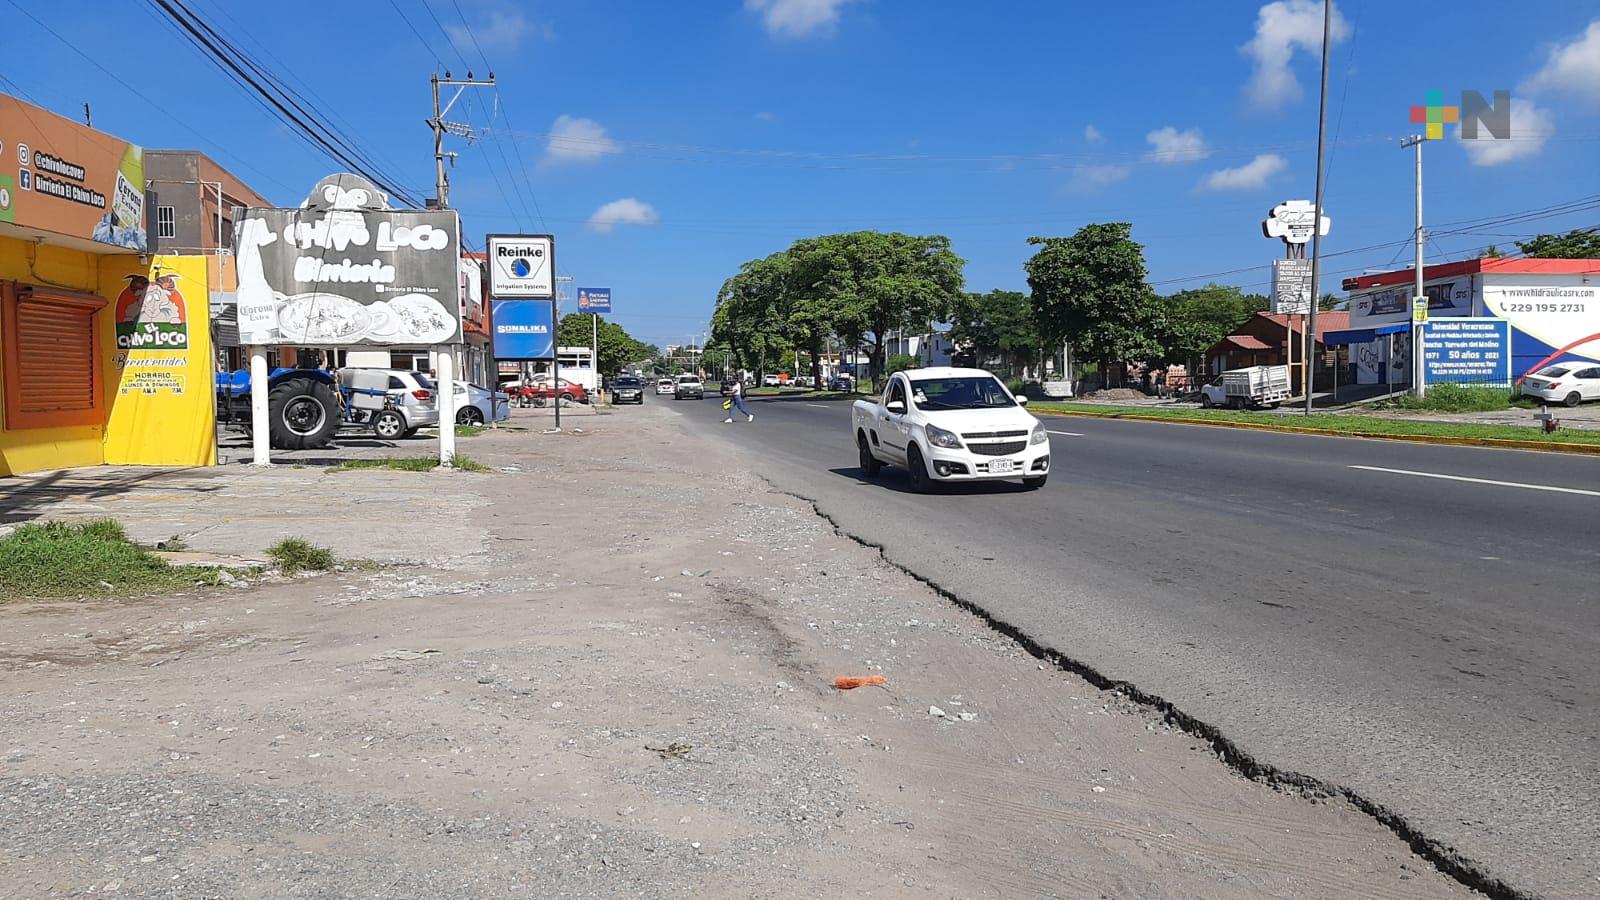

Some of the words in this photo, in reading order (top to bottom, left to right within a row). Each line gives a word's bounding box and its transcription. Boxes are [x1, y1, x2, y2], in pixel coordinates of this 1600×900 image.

[35, 152, 84, 180] @chivolocover
[35, 175, 65, 196] Birrieria
[66, 184, 72, 198] El
[72, 186, 90, 203] Chivo
[91, 191, 105, 207] Loco
[118, 175, 141, 207] Corona
[120, 195, 137, 215] Extra
[498, 246, 543, 257] Reinke
[293, 256, 396, 283] Birrieria
[496, 283, 523, 291] Irrigation
[524, 283, 547, 291] Systems
[240, 304, 274, 316] Corona
[1510, 304, 1532, 312] 229
[1536, 304, 1557, 312] 195
[1560, 304, 1585, 312] 2731
[249, 313, 270, 321] Extra
[144, 322, 160, 334] EL
[497, 325, 548, 334] SONALIKA
[1449, 350, 1460, 359] 50
[1461, 350, 1480, 359] años
[112, 353, 187, 370] Bienvenidos
